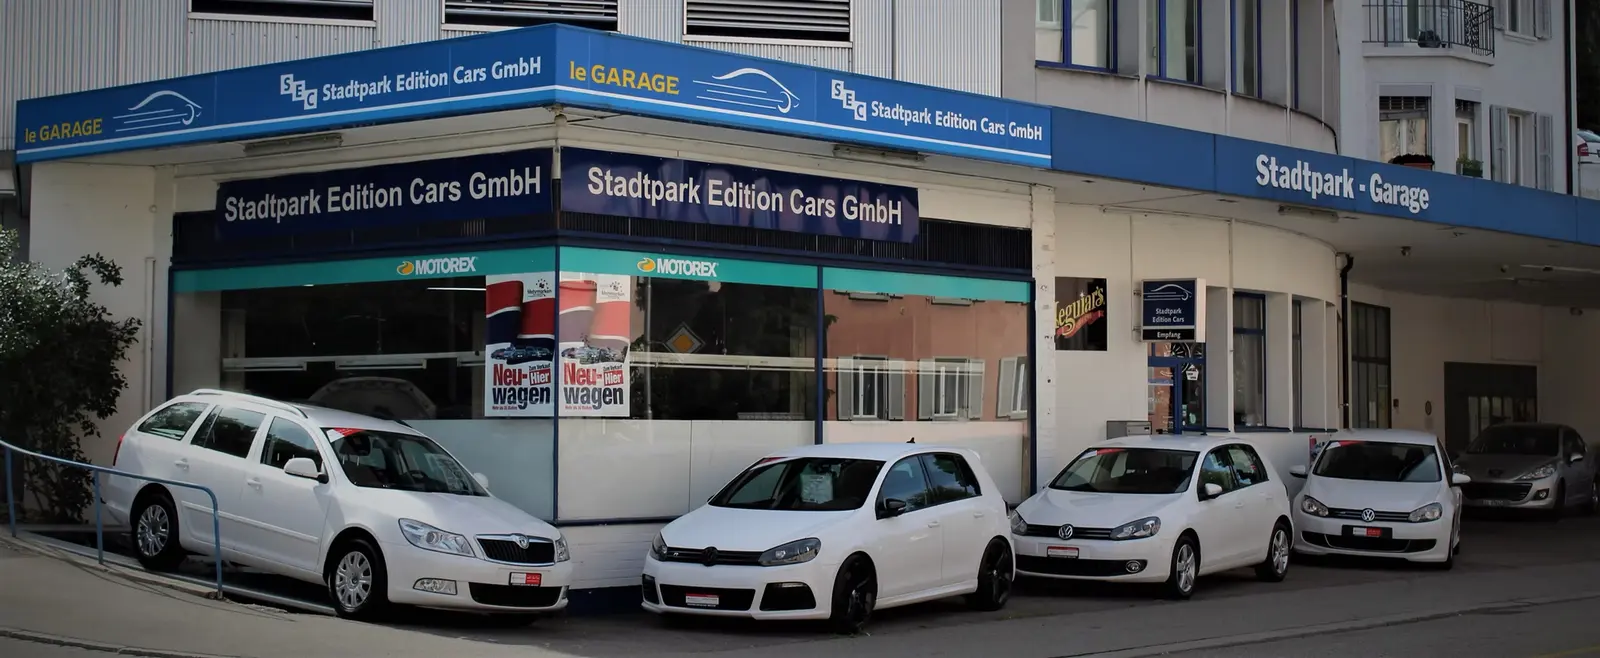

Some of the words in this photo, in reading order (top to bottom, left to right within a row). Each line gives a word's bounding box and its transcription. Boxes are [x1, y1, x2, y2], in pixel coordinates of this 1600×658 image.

[322, 77, 392, 102] Stadtpark
[396, 70, 448, 92] Edition
[453, 65, 487, 85] Cars
[491, 56, 542, 80] GmbH
[569, 60, 587, 81] le
[591, 64, 680, 96] GARAGE
[282, 75, 317, 108] SEC
[833, 81, 866, 120] SEC
[24, 127, 37, 144] le
[39, 117, 103, 142] GARAGE
[871, 100, 932, 126] Stadtpark
[935, 110, 977, 132] Edition
[980, 117, 1006, 135] Cars
[1008, 121, 1043, 141] GmbH
[224, 188, 321, 223] Stadtpark
[327, 182, 403, 213] Edition
[409, 177, 462, 205] Cars
[468, 166, 541, 200] GmbH
[587, 166, 701, 207] Stadtpark
[708, 178, 784, 213] Edition
[790, 188, 836, 218] Cars
[842, 194, 902, 225] GmbH
[1255, 153, 1355, 200] Stadtpark
[1369, 173, 1430, 214] Garage
[415, 256, 476, 275] MOTOREX
[656, 258, 718, 277] MOTOREX
[1155, 307, 1182, 316] Stadtpark
[1157, 331, 1181, 340] Empfang
[493, 363, 528, 386] Neu-
[530, 371, 550, 385] Hier
[564, 362, 603, 386] Neu-
[604, 372, 622, 385] Hier
[492, 386, 551, 410] wagen
[563, 386, 624, 410] wagen
